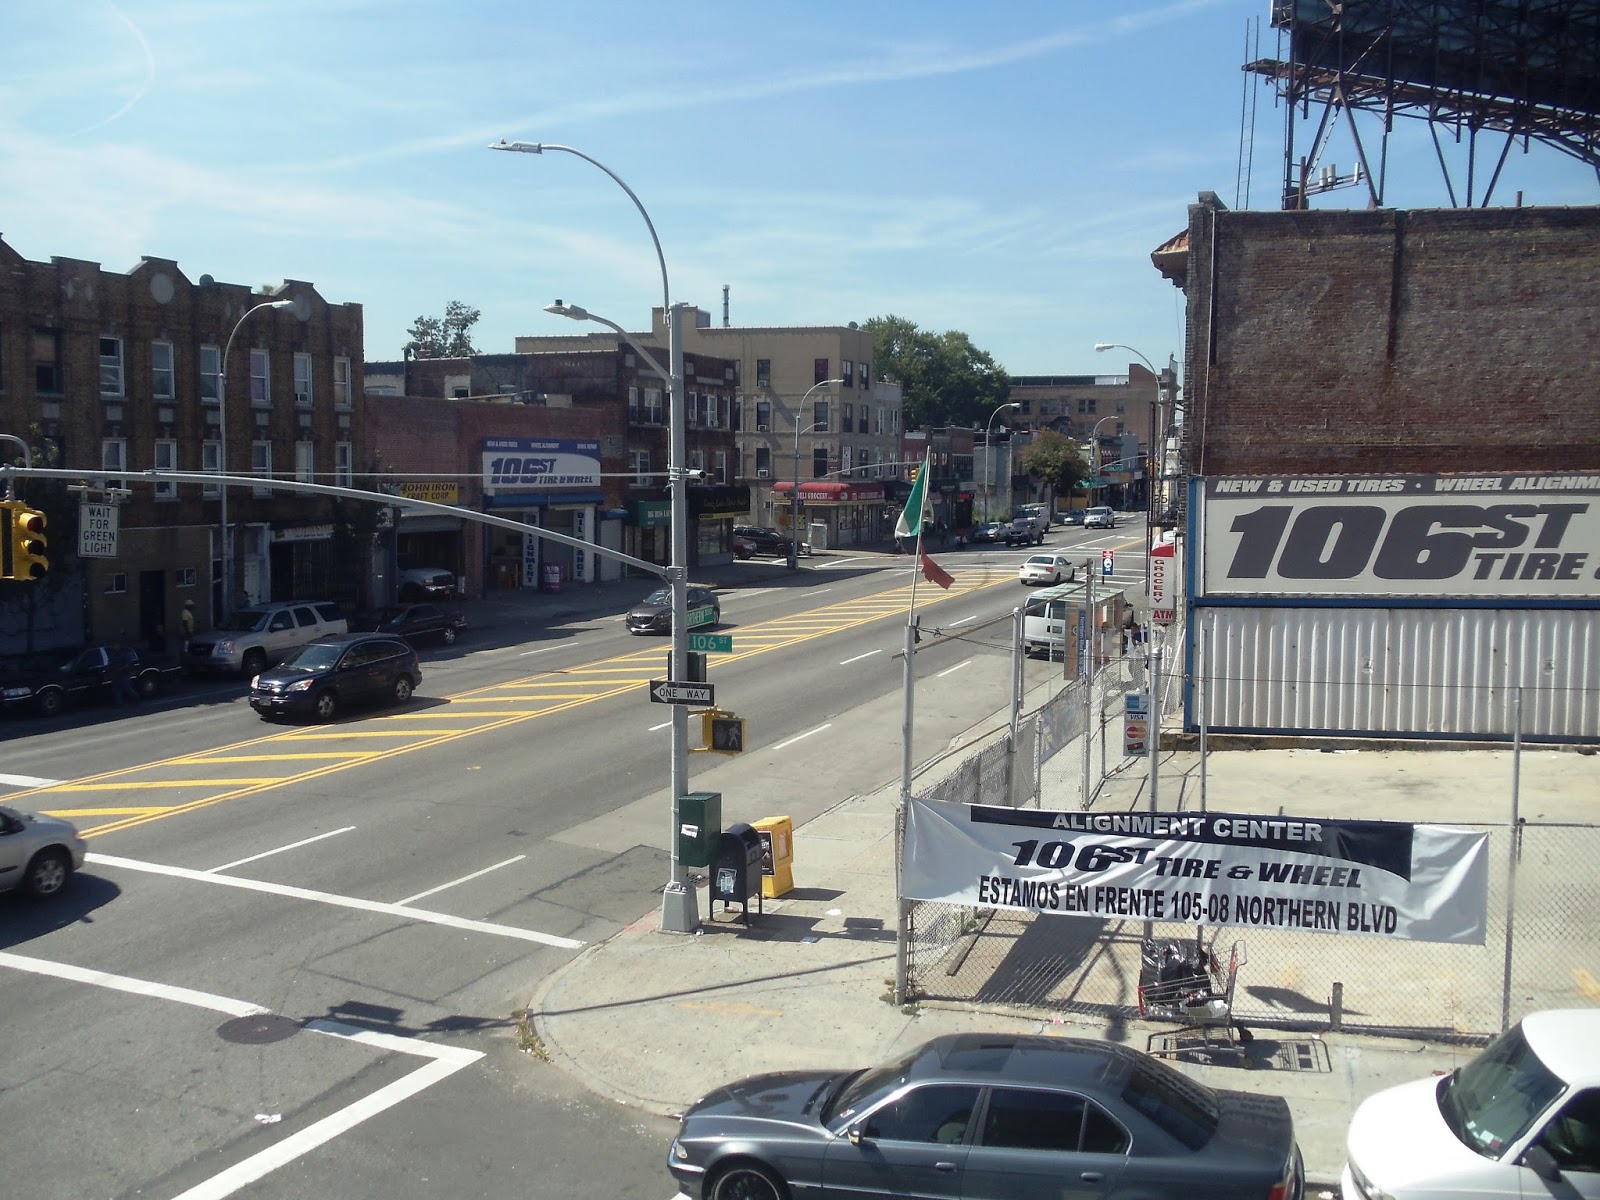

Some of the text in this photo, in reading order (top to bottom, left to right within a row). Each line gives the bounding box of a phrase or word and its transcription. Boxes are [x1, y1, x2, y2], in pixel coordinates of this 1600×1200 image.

[431, 483, 457, 491] IRON
[1215, 479, 1407, 493] NEW & USED TIRES
[1435, 477, 1503, 491] WHEEL
[88, 507, 111, 518] WAIT
[90, 519, 109, 529] FOR
[83, 530, 115, 542] GREEN
[84, 542, 112, 554] LIGHT
[525, 533, 536, 583] LIGNMENT
[1473, 552, 1590, 580] TIRE
[1153, 559, 1165, 603] GROCERY
[1153, 609, 1174, 619] ATM
[692, 635, 728, 650] 106 ST
[659, 688, 706, 699] ONE WAY
[1052, 813, 1323, 842] ALIGNMENT CENTER
[1155, 856, 1222, 879] TIRE
[1227, 865, 1254, 881] &
[1258, 862, 1362, 889] WHEEL
[978, 875, 1398, 935] ESTAMOS EN FRENTE 105-08 NORTHERN BLVD
